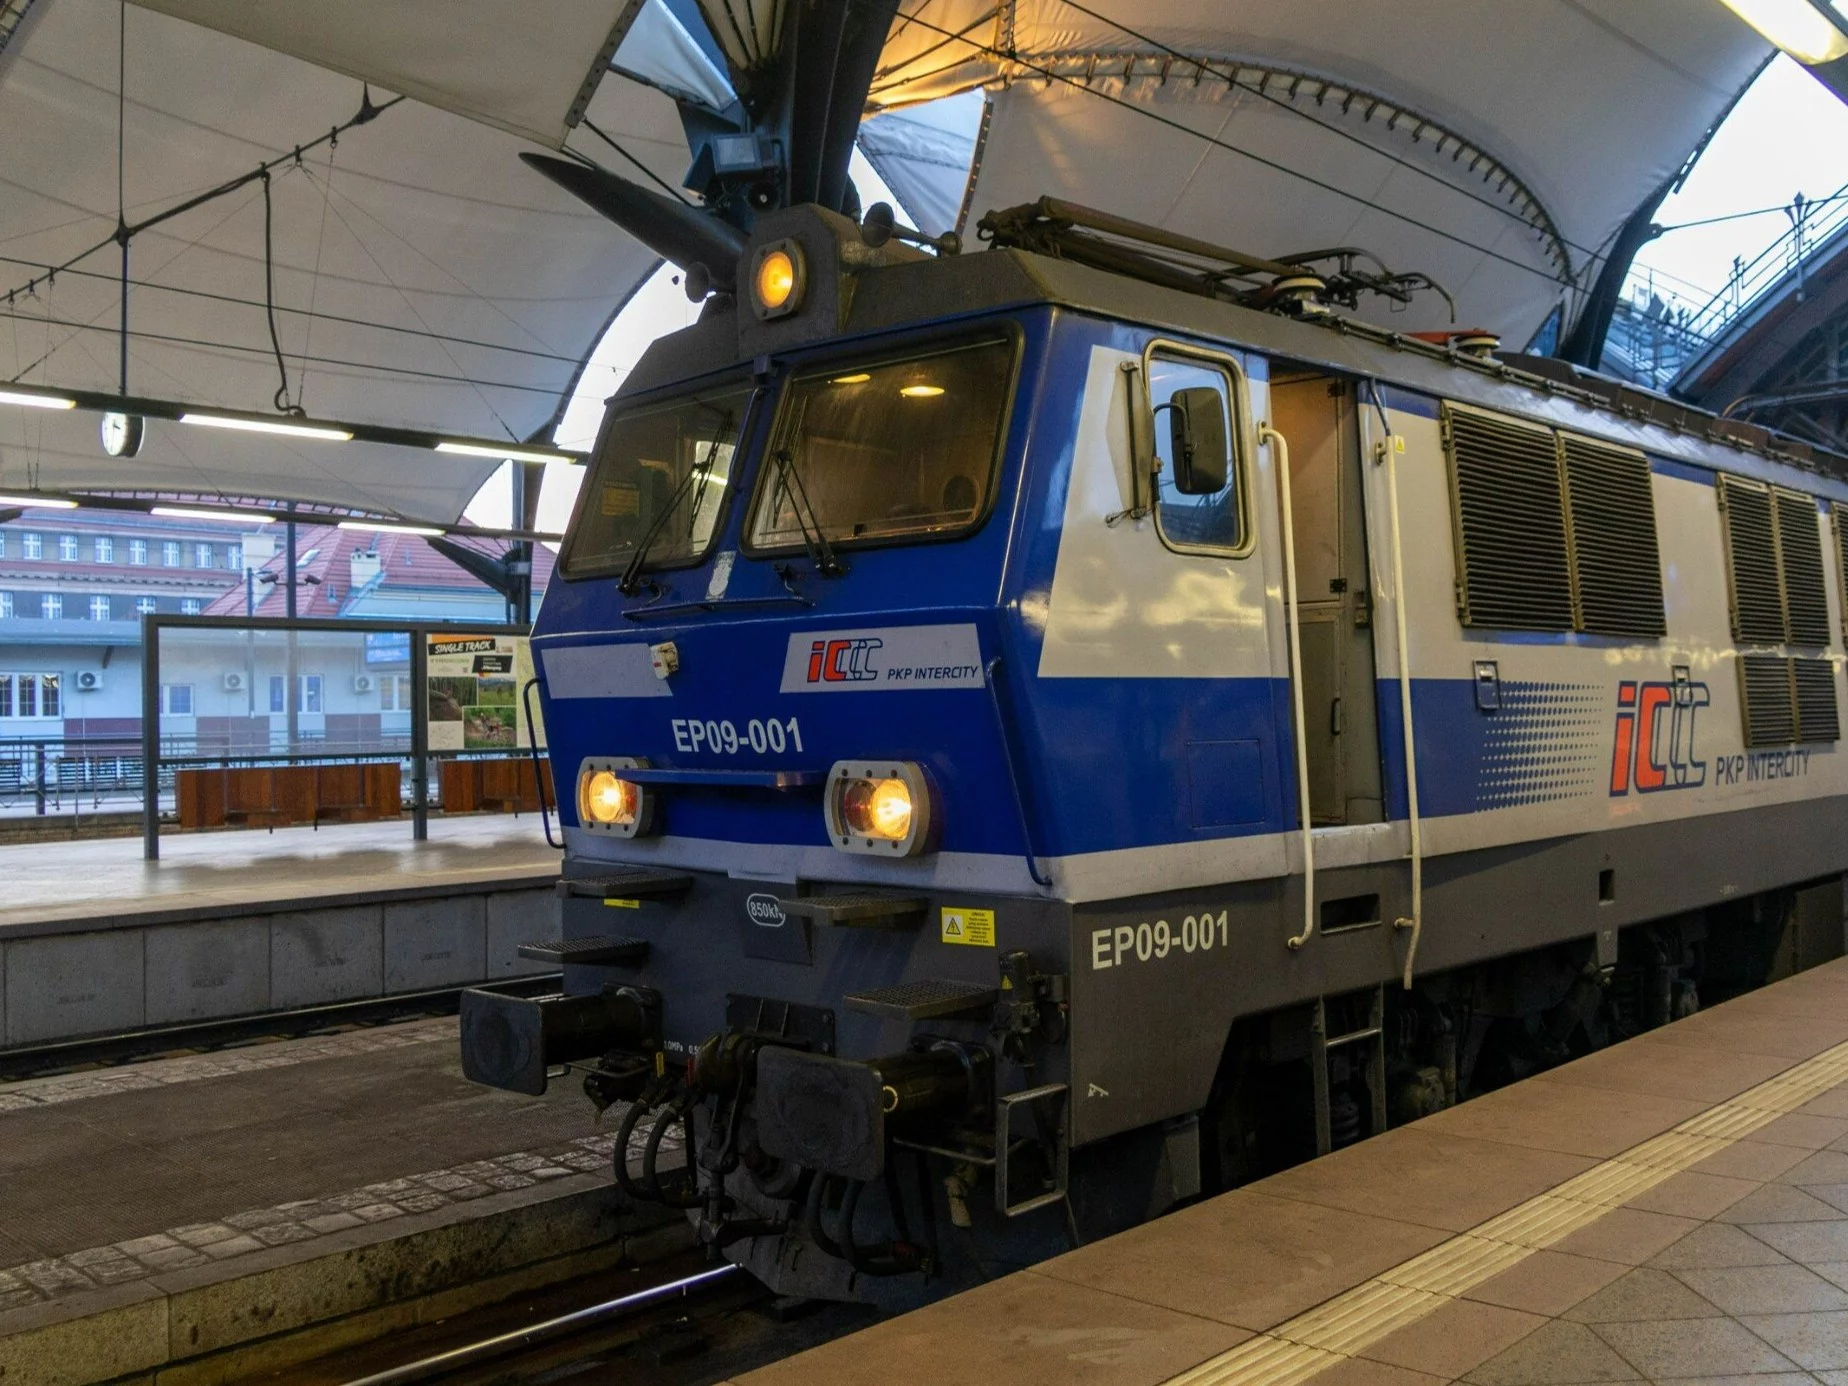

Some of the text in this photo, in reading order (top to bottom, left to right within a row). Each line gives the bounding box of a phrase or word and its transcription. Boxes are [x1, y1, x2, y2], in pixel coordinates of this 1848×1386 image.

[435, 642, 463, 654] SINGLE
[465, 640, 491, 652] TRACK
[887, 665, 979, 681] PKP INTERCITY
[671, 716, 805, 755] EP09-001
[1715, 749, 1811, 786] PKP INTERCITY
[1091, 909, 1229, 971] EP09-001
